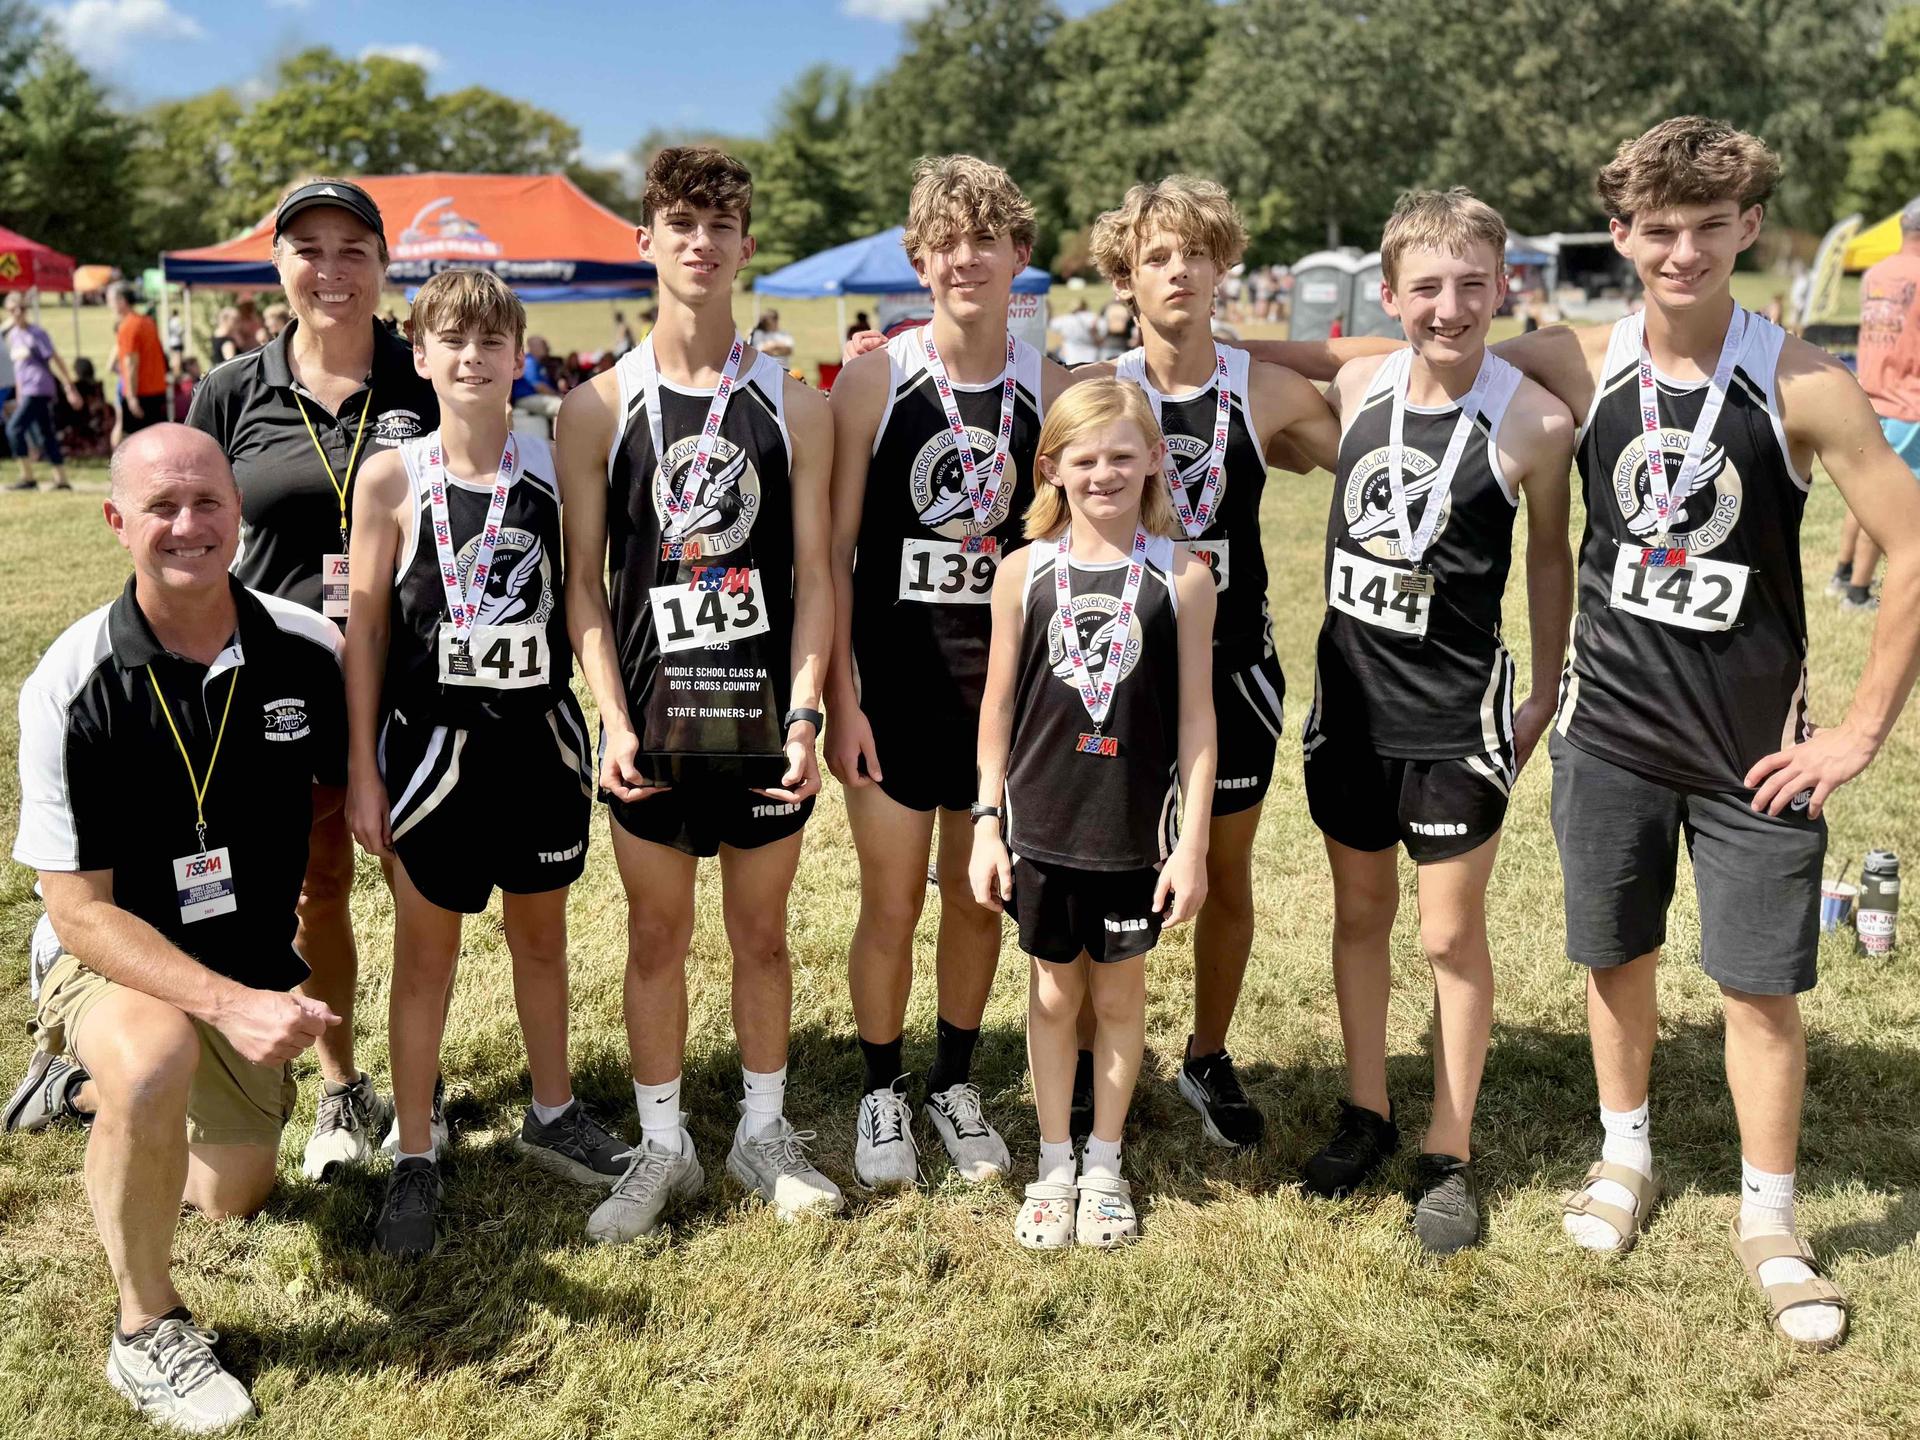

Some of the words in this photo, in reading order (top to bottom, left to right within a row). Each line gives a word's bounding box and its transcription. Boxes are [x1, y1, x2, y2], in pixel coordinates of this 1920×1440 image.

[1008, 307, 1038, 319] NTRY
[1167, 437, 1205, 455] GNET
[913, 445, 941, 507] CENTRAL
[1616, 447, 1644, 513] CENTRAL
[1348, 460, 1375, 518] CENTRAL
[1365, 479, 1378, 500] CROSS
[709, 493, 756, 552] TIGERS
[1672, 494, 1738, 551] TIGERS
[688, 566, 750, 593] TSSAA
[909, 552, 997, 594] 139
[1338, 566, 1421, 623] 144
[1622, 561, 1732, 622] 142
[663, 586, 759, 642] 143
[1076, 615, 1102, 626] COUNTRY
[451, 636, 542, 679] 41
[704, 641, 730, 651] 2025
[664, 666, 694, 677] MIDDLE
[696, 666, 727, 678] SCHOOL
[729, 668, 754, 678] CLASS
[756, 668, 767, 679] AA
[670, 681, 692, 691] BOYS
[694, 681, 721, 692] CROSS
[723, 682, 761, 692] COUNTRY
[667, 707, 697, 718] STATE
[699, 707, 763, 719] RUNNERS-UP
[1215, 775, 1258, 790] IGERS
[1409, 821, 1468, 836] TIGERS
[185, 856, 222, 879] TSSAA
